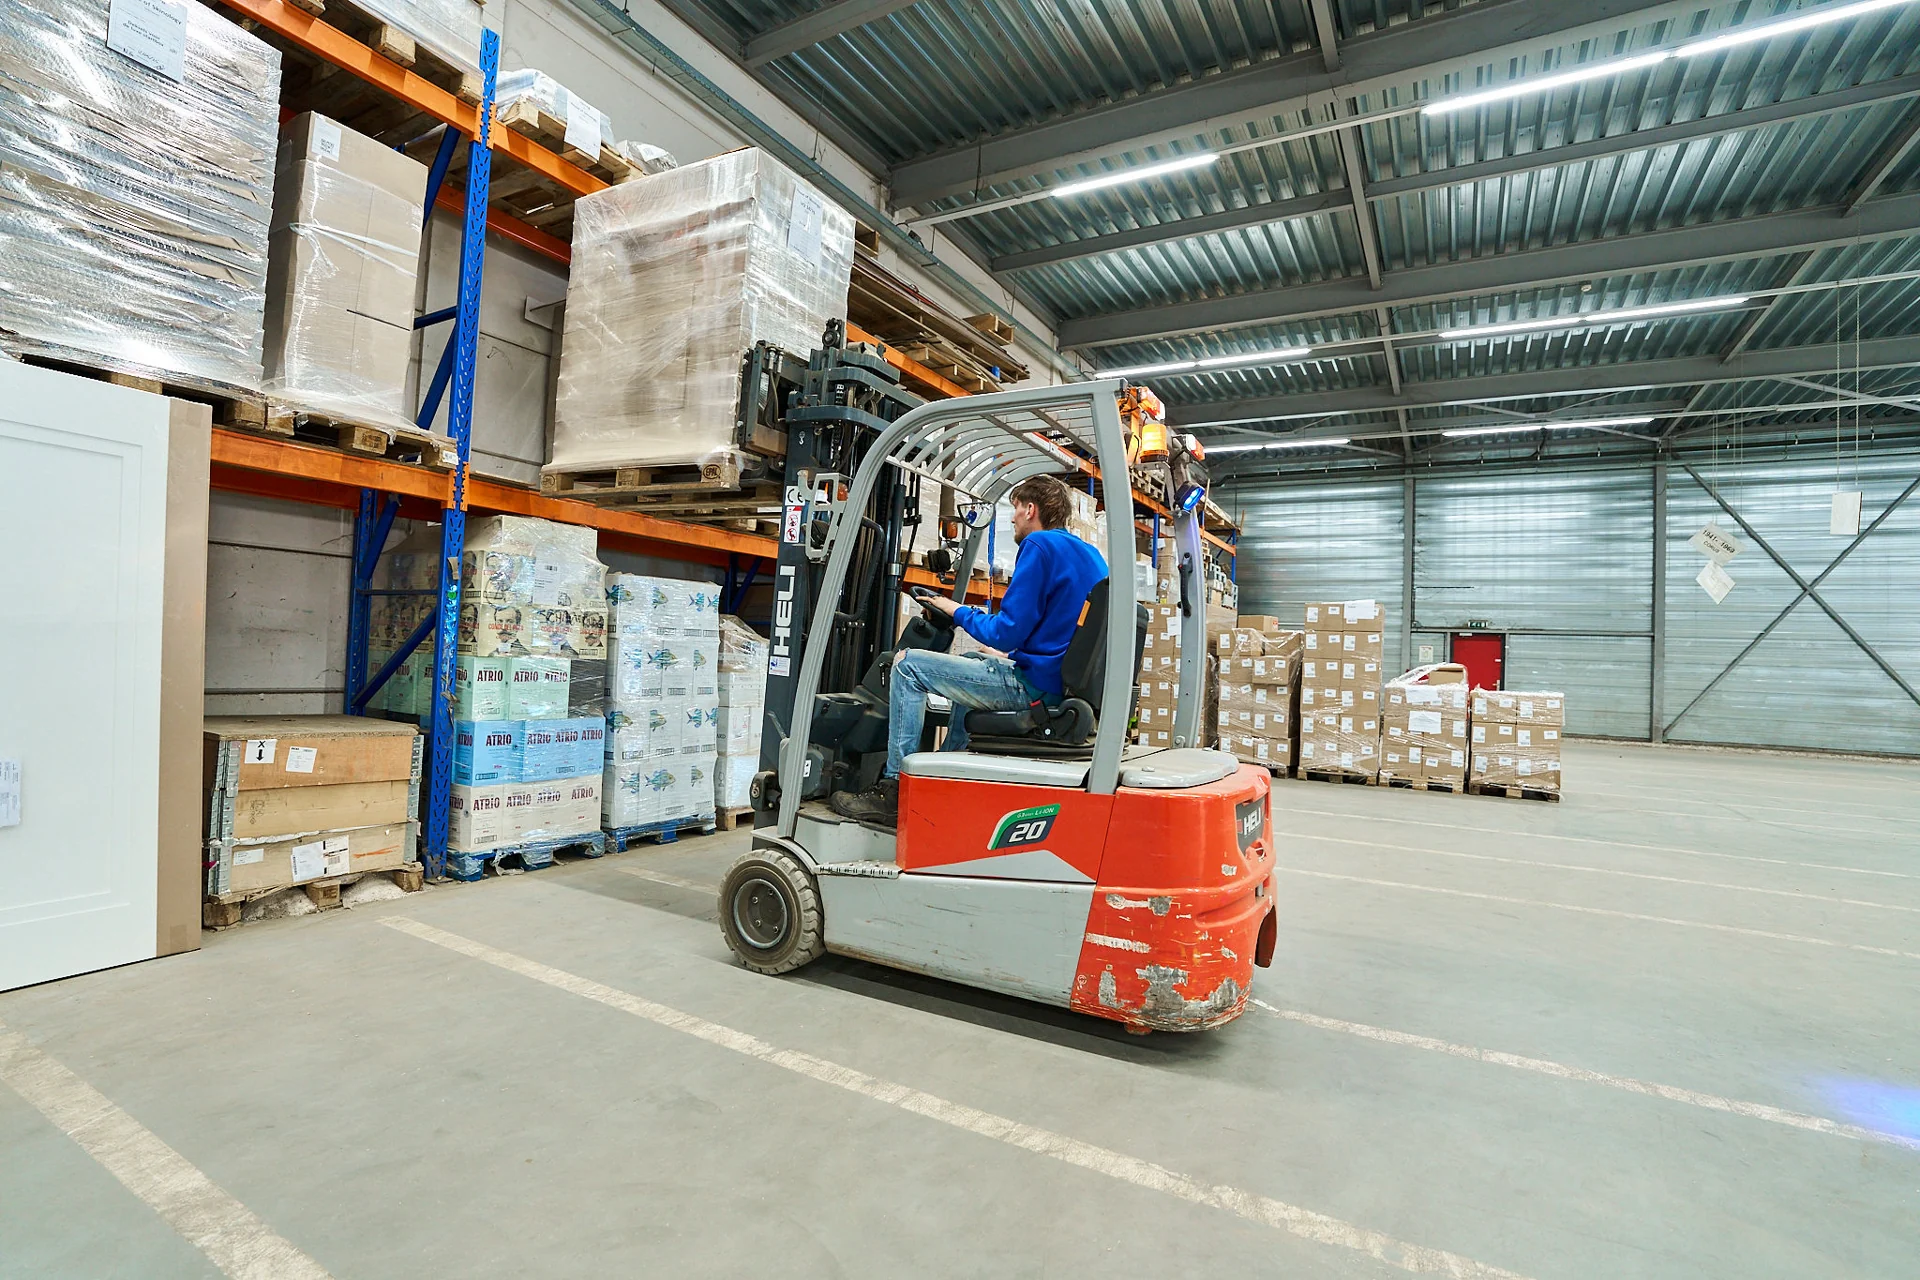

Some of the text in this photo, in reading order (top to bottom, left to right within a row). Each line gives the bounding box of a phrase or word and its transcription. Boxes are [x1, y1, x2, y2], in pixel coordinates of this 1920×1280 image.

[773, 565, 796, 656] HELI
[477, 670, 504, 682] ATRIO
[513, 671, 539, 683] ATRIO
[545, 671, 568, 683] ATRIO
[485, 733, 512, 747] ATRIO
[527, 733, 551, 745] ATRIO
[555, 730, 579, 743] ATRIO
[582, 729, 603, 741] ATRIO
[537, 790, 561, 804] ATRIO
[571, 786, 594, 800] ATRIO
[473, 796, 500, 811] ATRIO
[506, 793, 532, 808] ATRIO
[1243, 806, 1261, 836] HELI
[1008, 820, 1047, 843] 20
